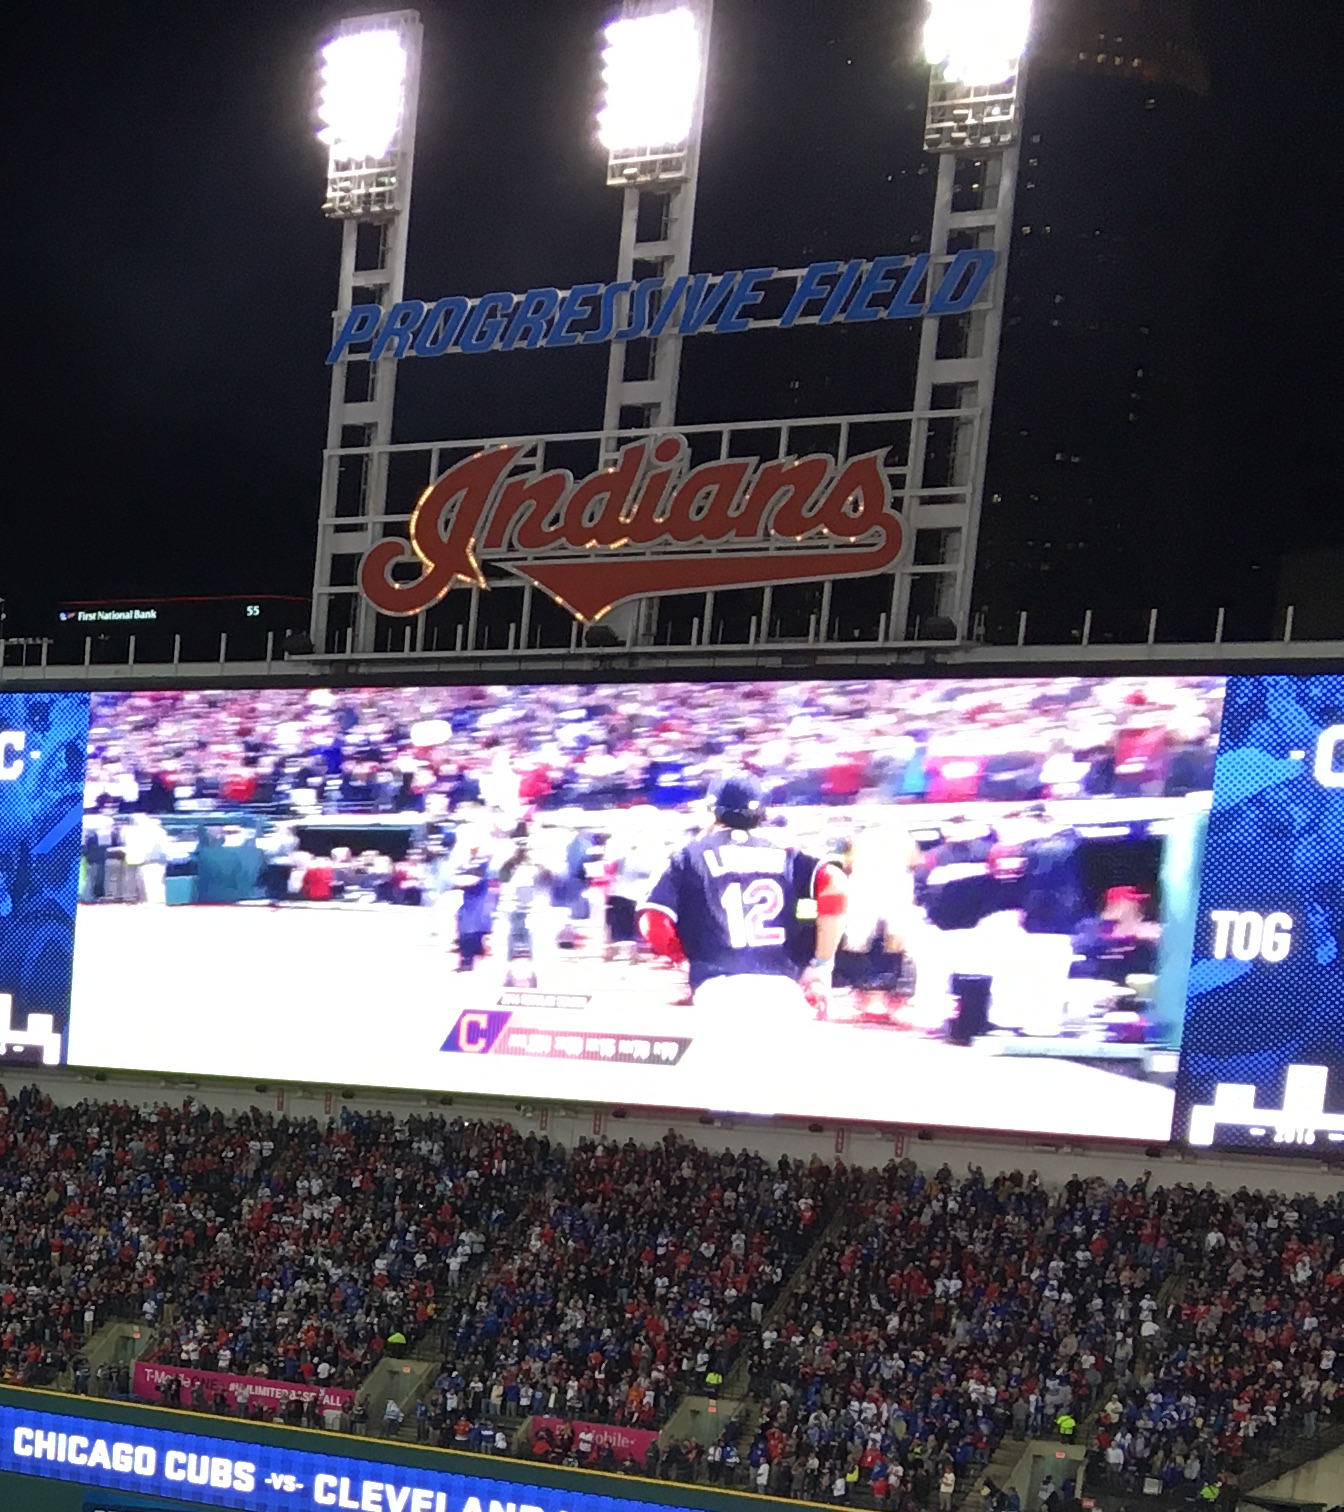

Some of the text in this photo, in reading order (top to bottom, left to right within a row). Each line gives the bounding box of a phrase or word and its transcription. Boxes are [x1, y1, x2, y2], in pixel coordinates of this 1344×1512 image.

[324, 248, 998, 365] PROGRESSIVE FIELD
[358, 431, 906, 624] Indians
[77, 608, 157, 622] First National Bank
[720, 878, 786, 949] 12
[1212, 909, 1293, 964] TOG
[12, 1425, 156, 1477] CHICAGO
[164, 1449, 255, 1493] CUBS
